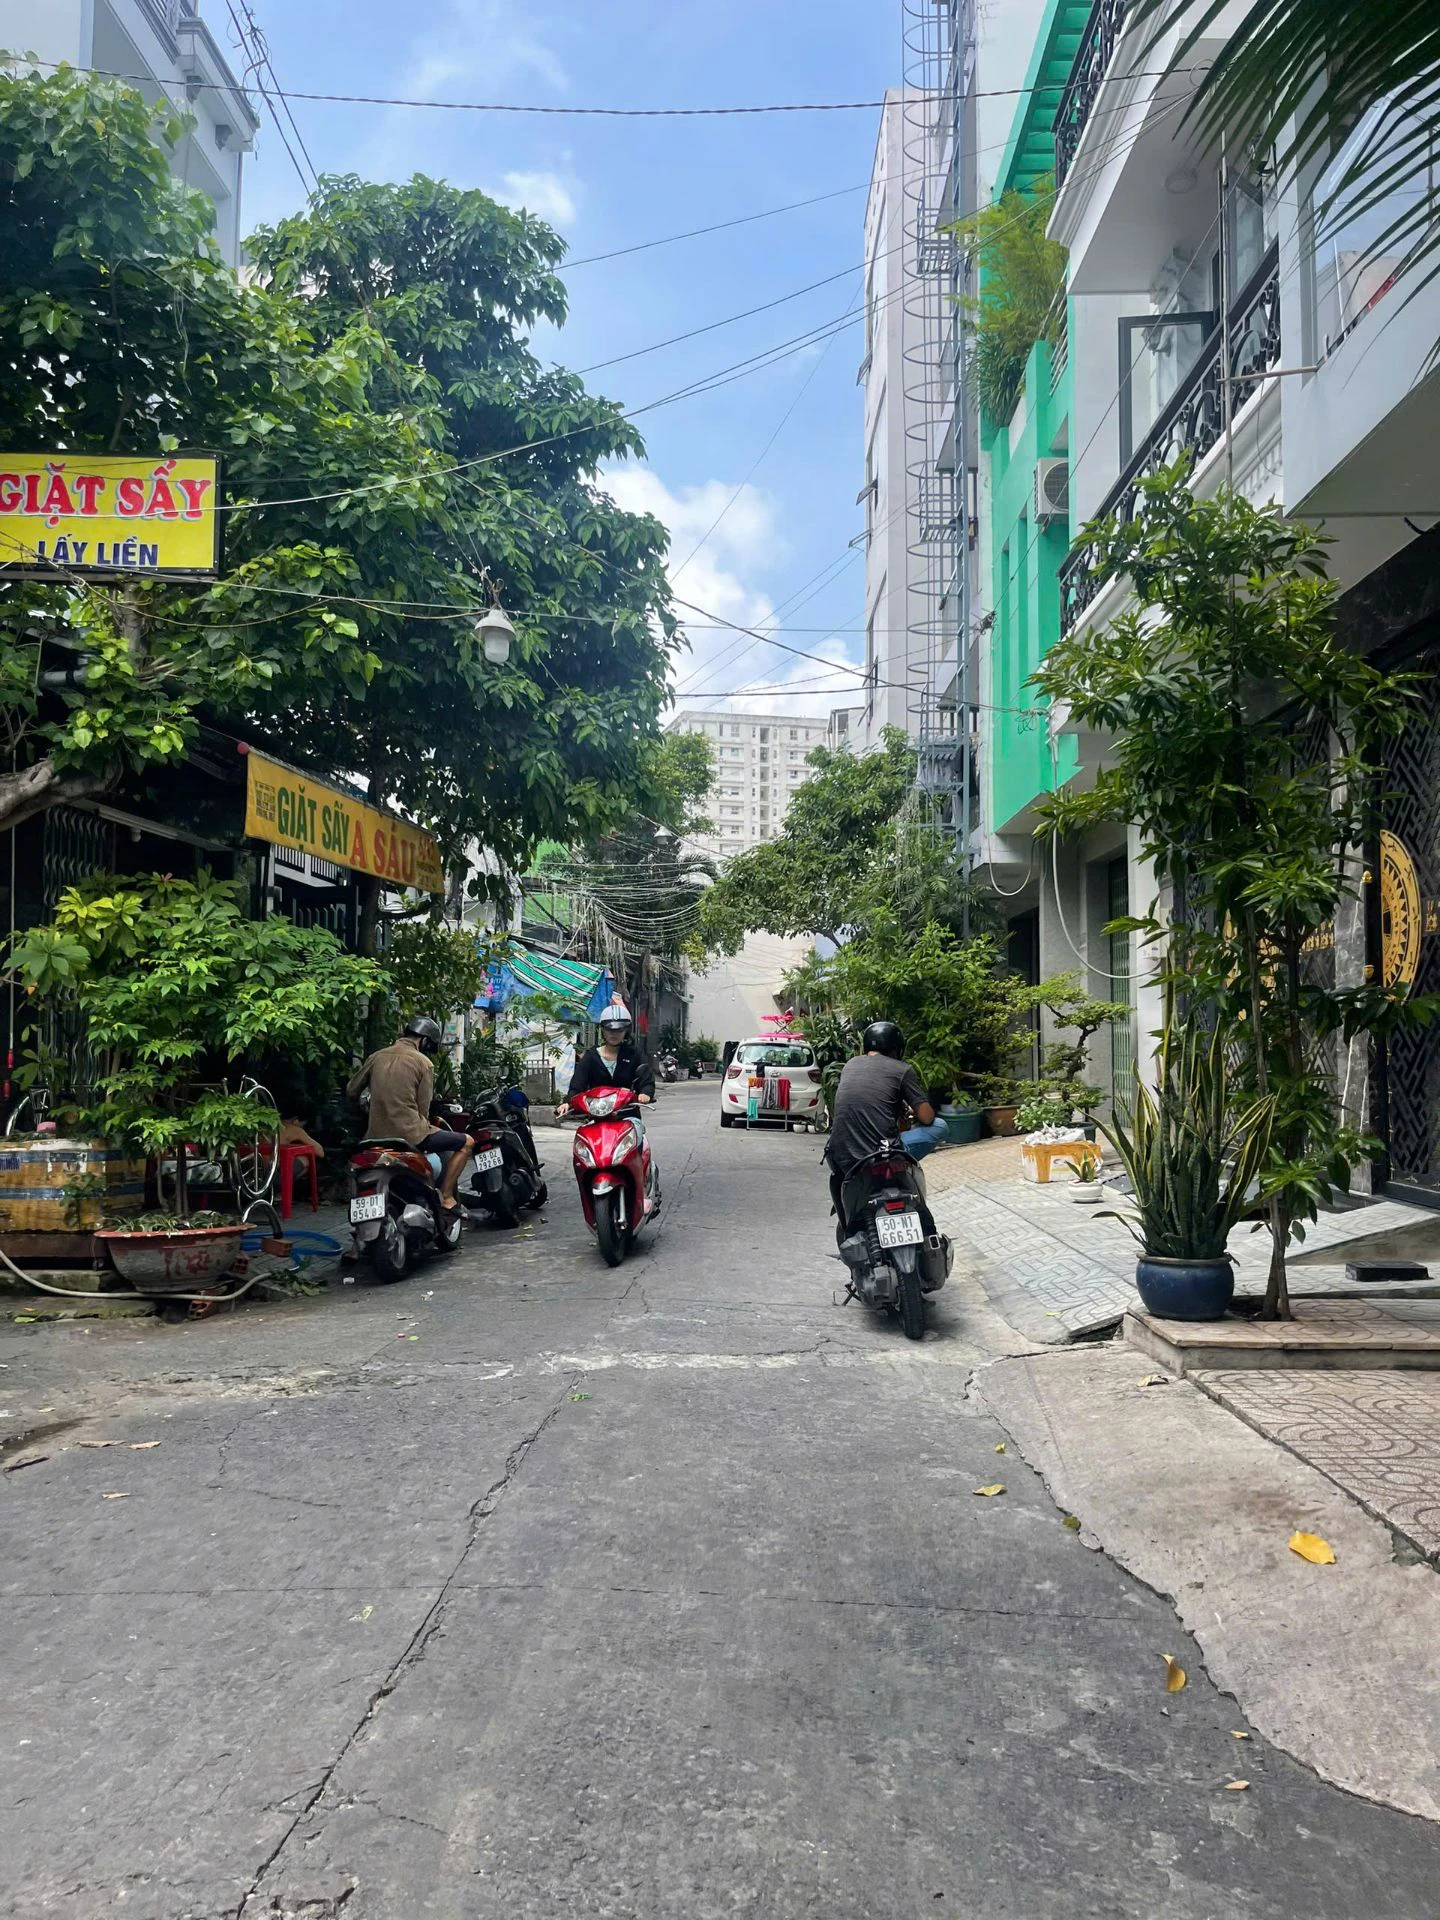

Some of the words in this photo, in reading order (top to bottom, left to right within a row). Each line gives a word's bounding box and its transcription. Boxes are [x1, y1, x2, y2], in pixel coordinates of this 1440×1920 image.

[0, 462, 105, 528] GIẶT
[117, 459, 212, 519] SẤY
[37, 533, 88, 564] LẤY
[97, 535, 158, 566] LIỀN
[276, 784, 317, 851] GIẶT
[321, 800, 350, 856] SẤY
[350, 819, 368, 870] A
[373, 821, 416, 883] SÁU
[356, 1195, 379, 1210] 59-D1
[883, 1216, 913, 1231] 50-N1
